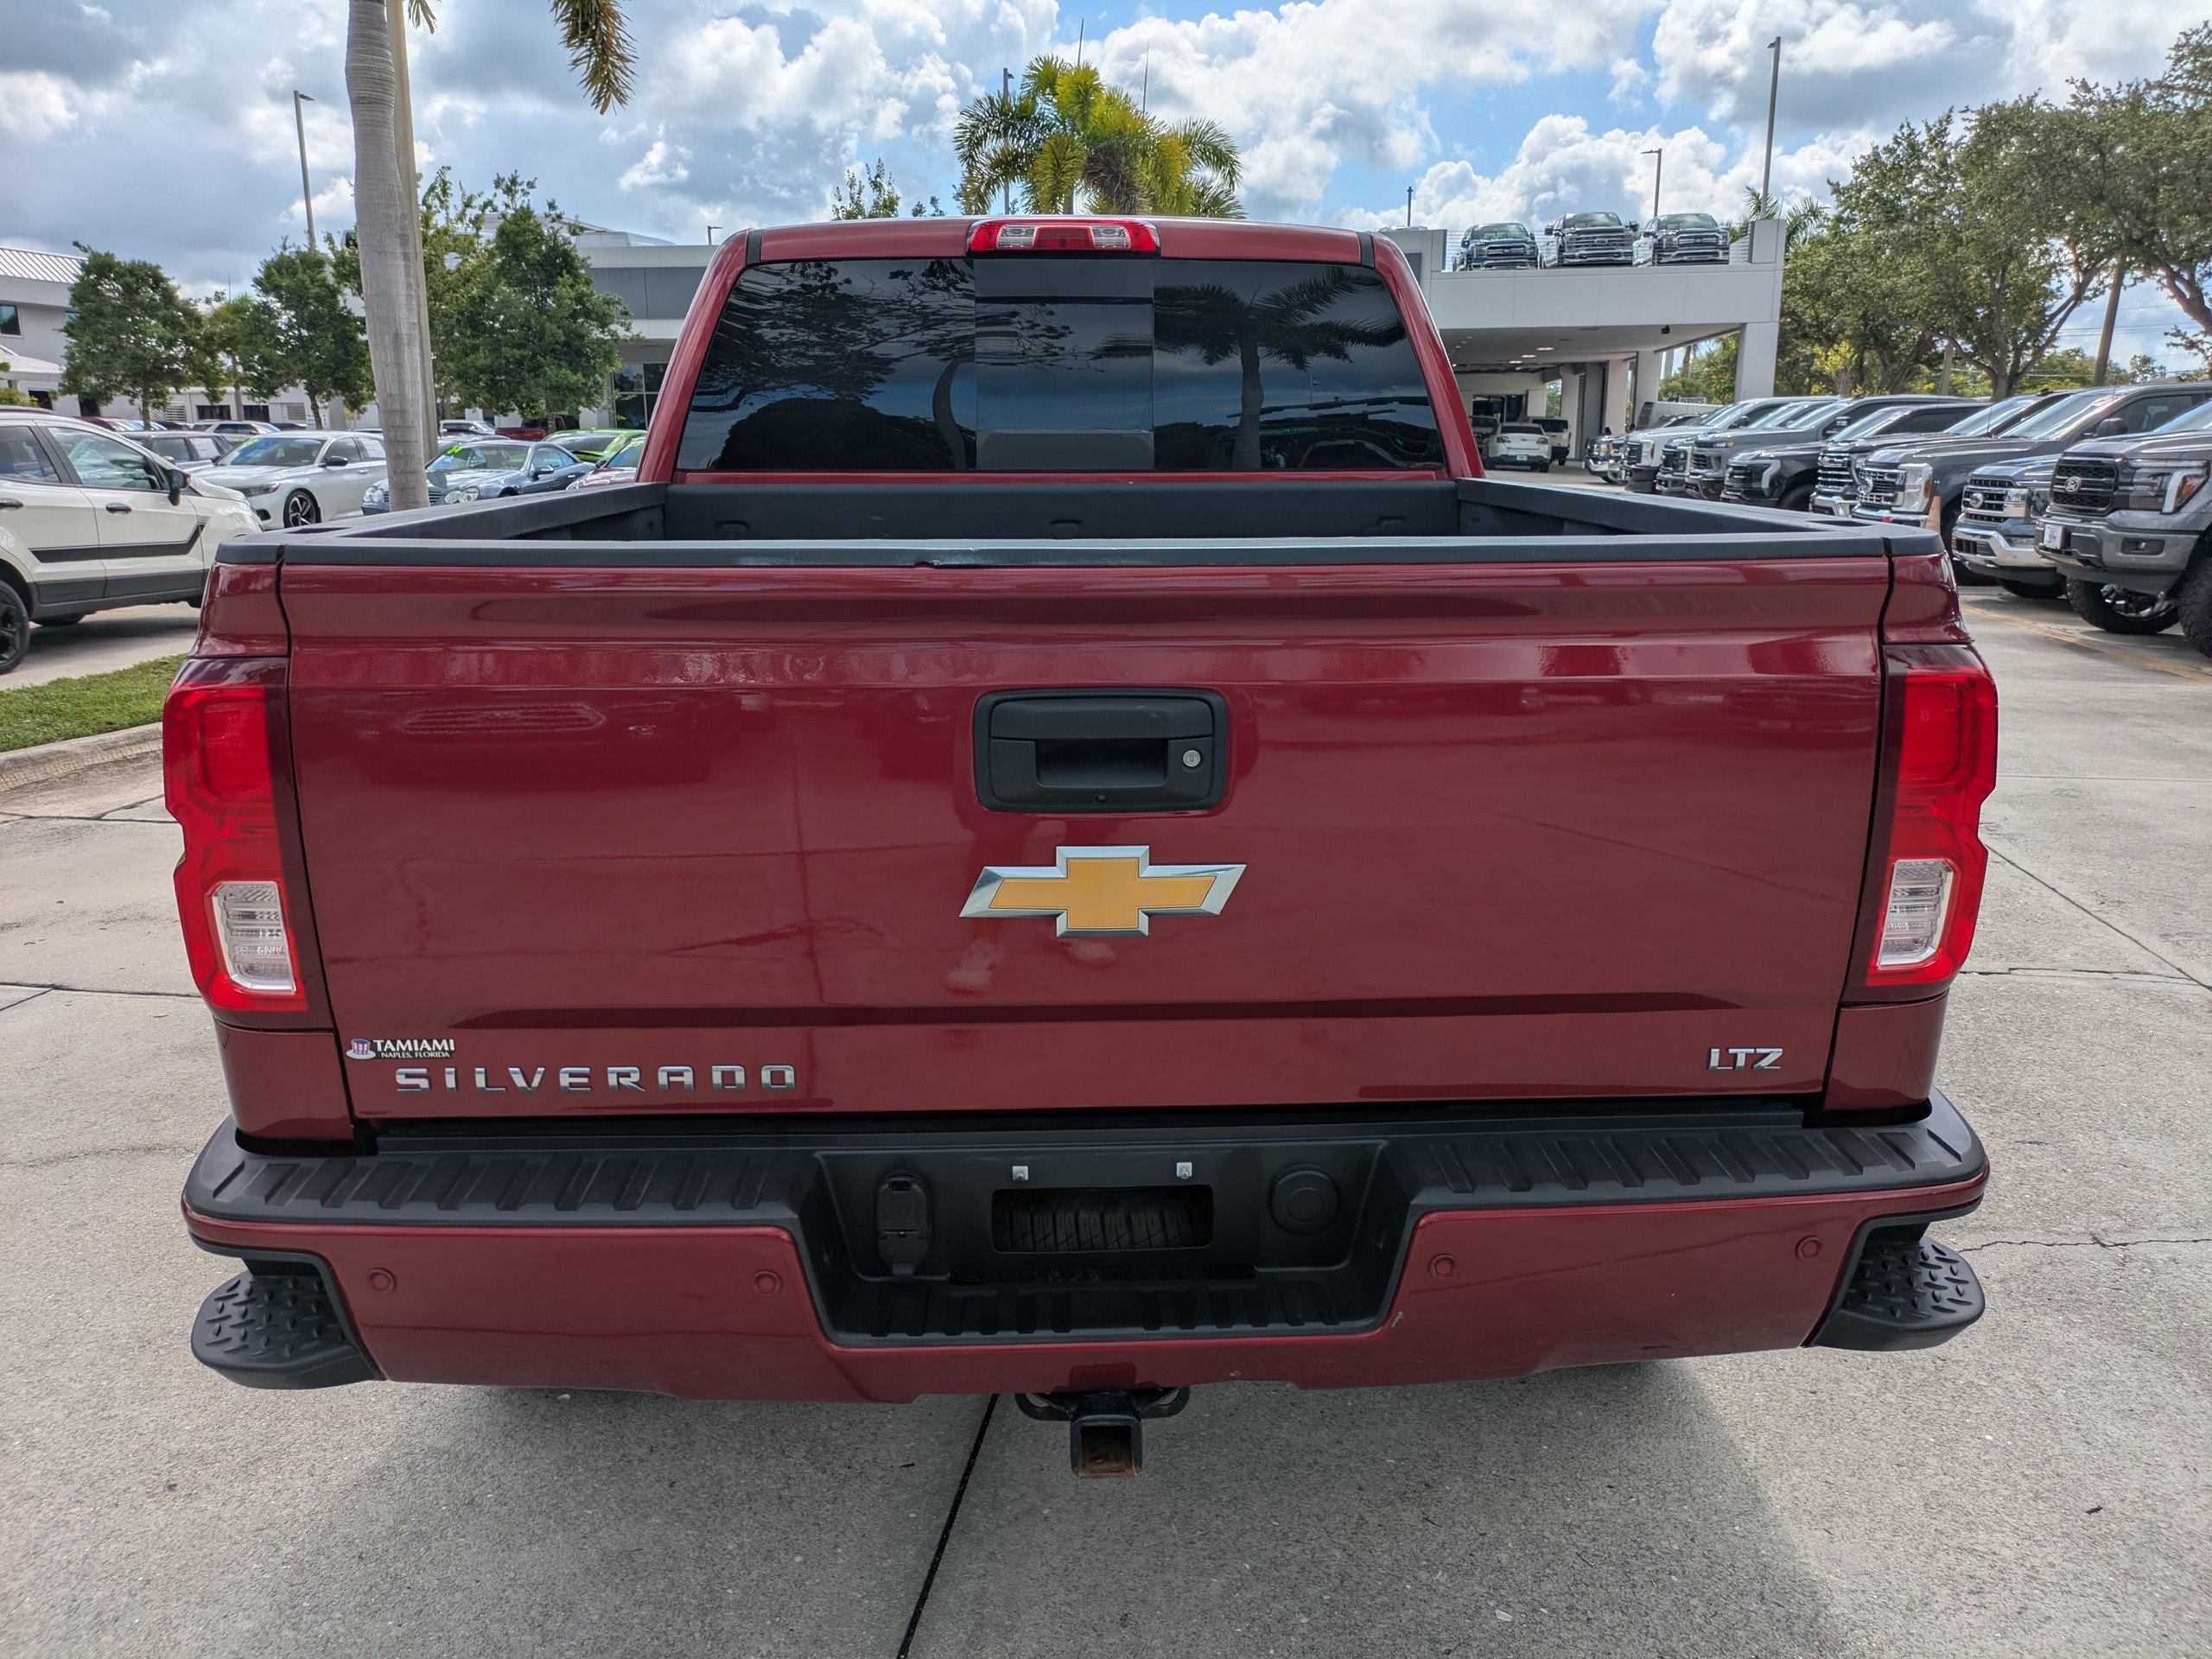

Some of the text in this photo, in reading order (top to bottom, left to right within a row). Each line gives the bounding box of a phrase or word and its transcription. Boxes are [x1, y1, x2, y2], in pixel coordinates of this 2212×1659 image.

[373, 1039, 455, 1052] TAMIAMI
[1708, 1048, 1783, 1071] LTZ
[395, 1065, 796, 1092] SILVERADO
